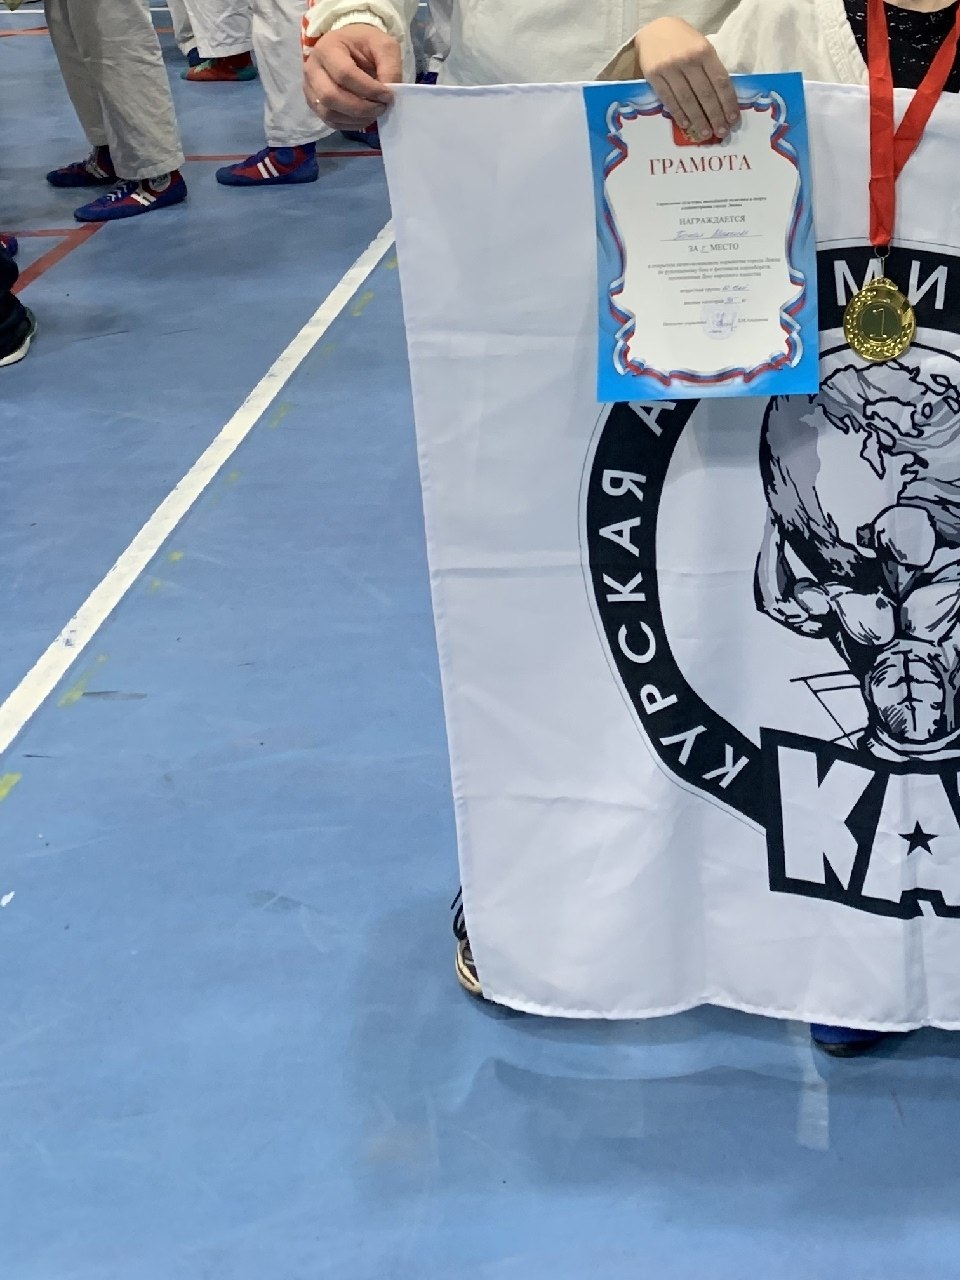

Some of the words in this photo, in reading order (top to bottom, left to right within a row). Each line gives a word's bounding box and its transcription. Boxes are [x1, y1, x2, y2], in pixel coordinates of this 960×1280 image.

[648, 153, 752, 176] ГРАМОТА
[679, 215, 746, 225] НАГРАЖДАЕТСЯ
[688, 245, 699, 253] ЗА
[710, 243, 739, 252] МЕСТО
[870, 307, 886, 338] 1
[601, 470, 749, 790] КУРСКАЯ
